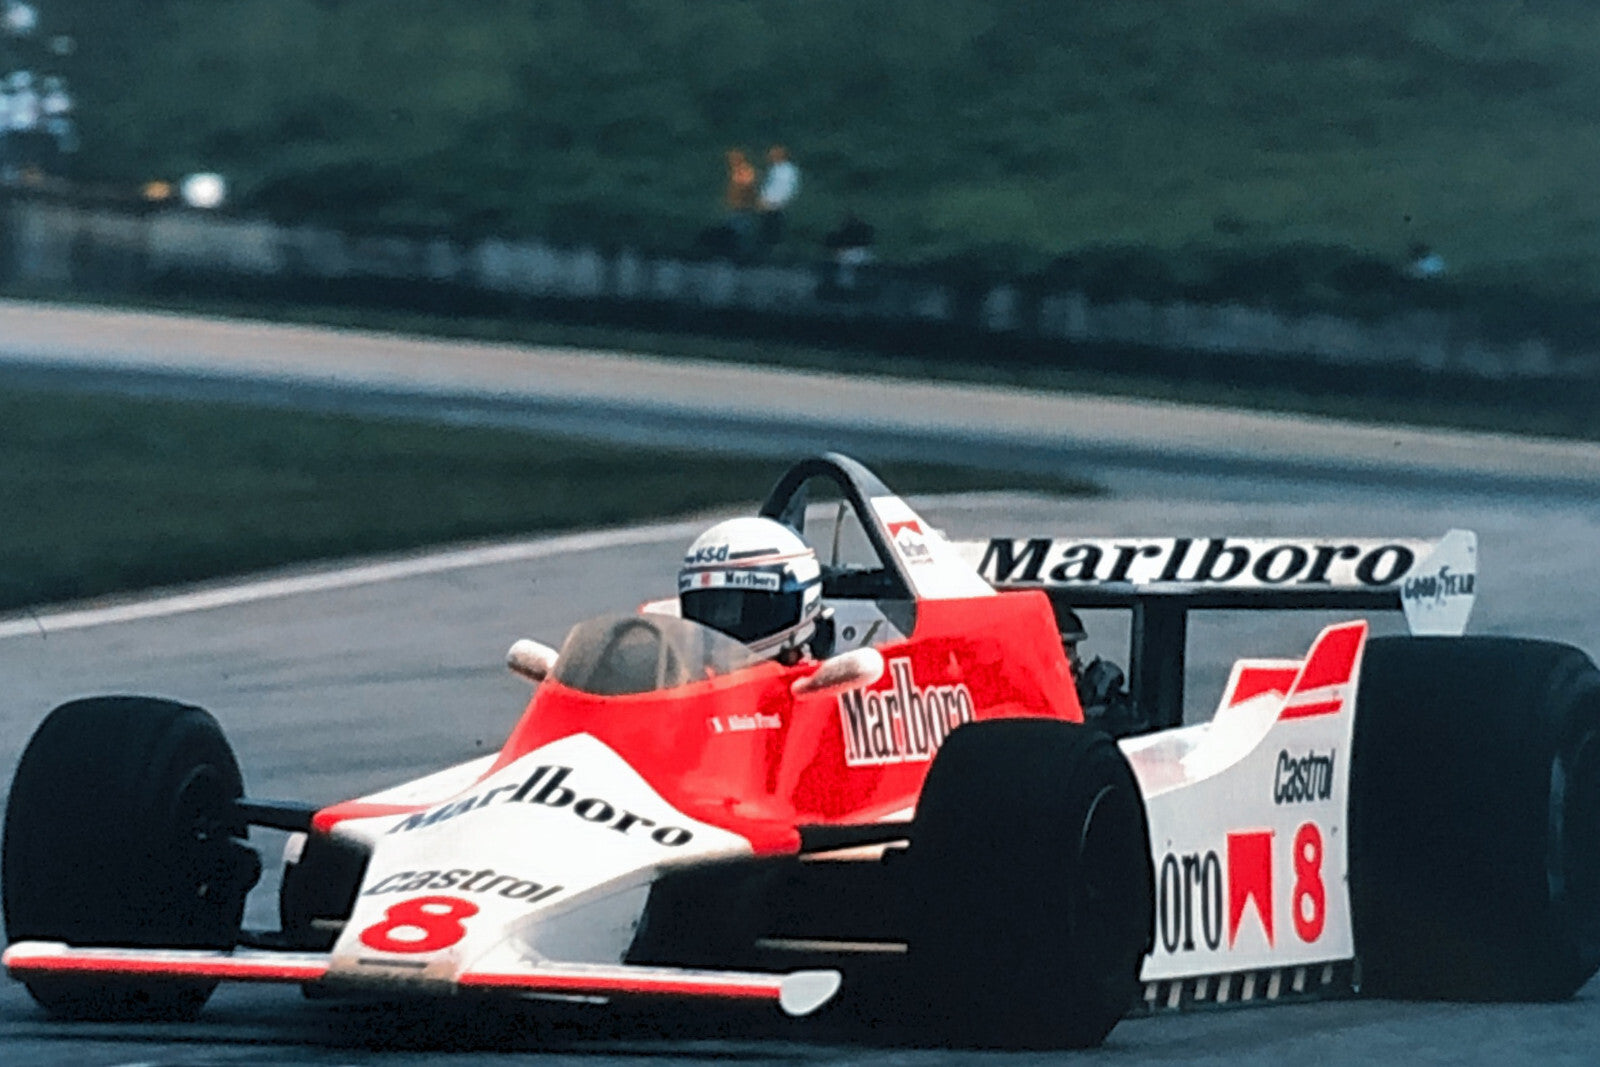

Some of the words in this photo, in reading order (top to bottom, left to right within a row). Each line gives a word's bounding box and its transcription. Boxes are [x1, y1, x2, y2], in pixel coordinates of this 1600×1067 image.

[977, 538, 1415, 586] Marlboro
[841, 662, 972, 760] Marlboro
[386, 764, 694, 847] Marlboro
[1273, 748, 1336, 805] Castrol
[1291, 822, 1326, 944] 8
[358, 895, 480, 953] 8
